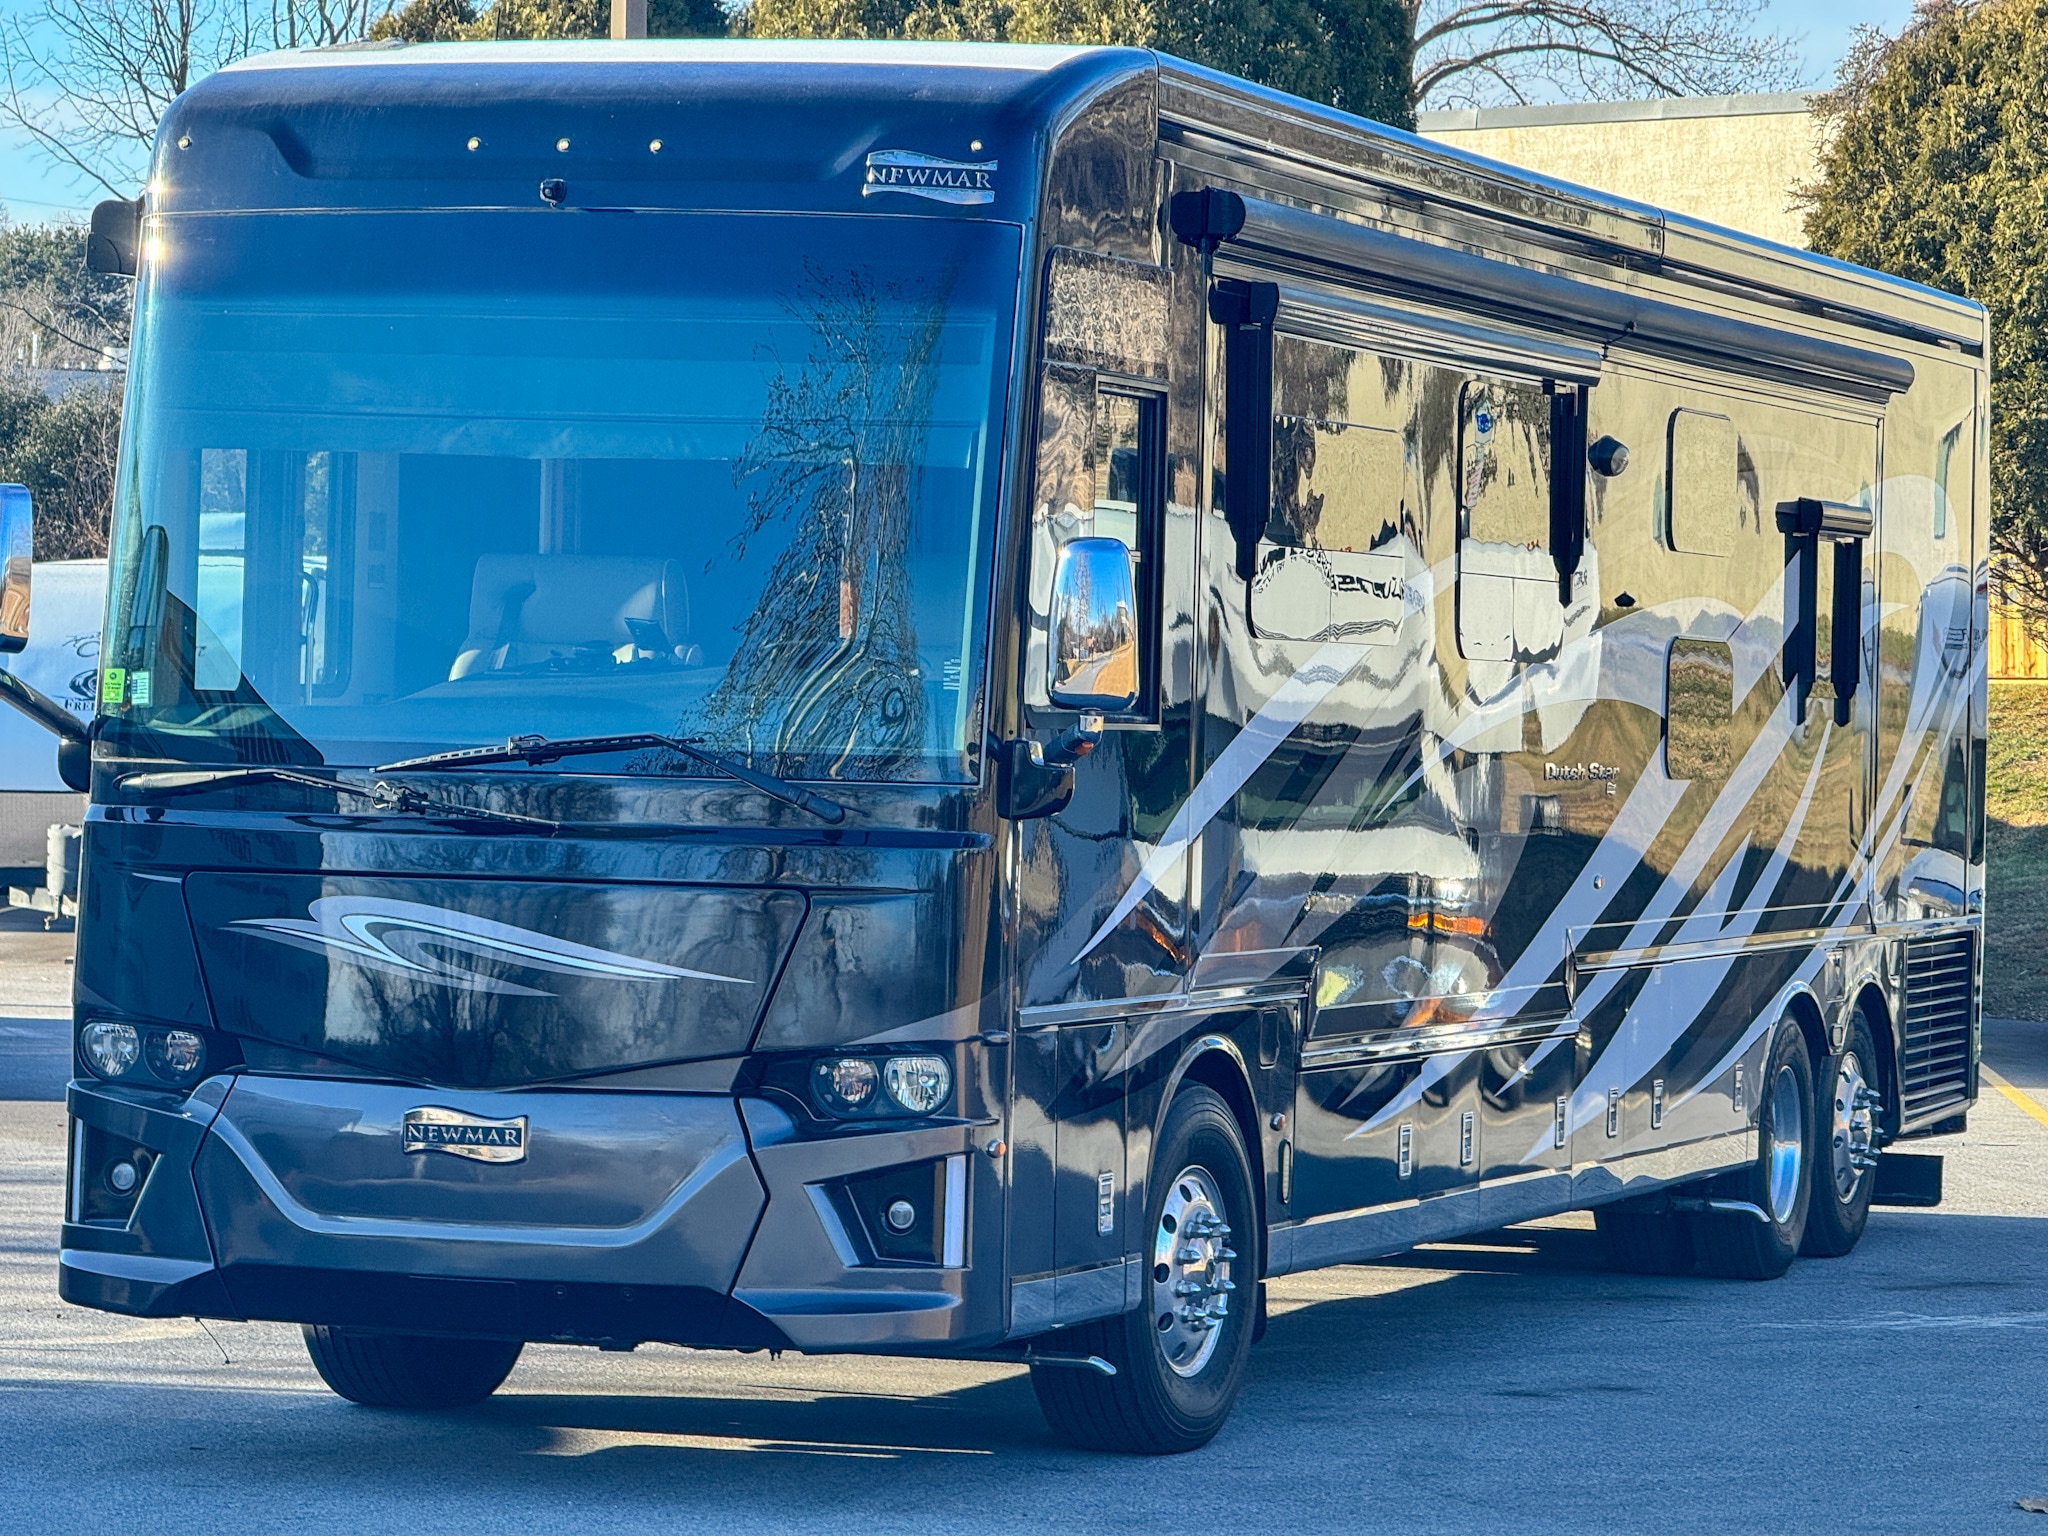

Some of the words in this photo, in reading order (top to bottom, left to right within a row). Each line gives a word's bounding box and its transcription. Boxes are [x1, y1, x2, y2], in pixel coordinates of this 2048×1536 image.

[866, 166, 992, 189] NEWMAR
[1543, 762, 1586, 781] Dutch
[1588, 762, 1620, 780] Star
[407, 1124, 521, 1145] NEWMAR
